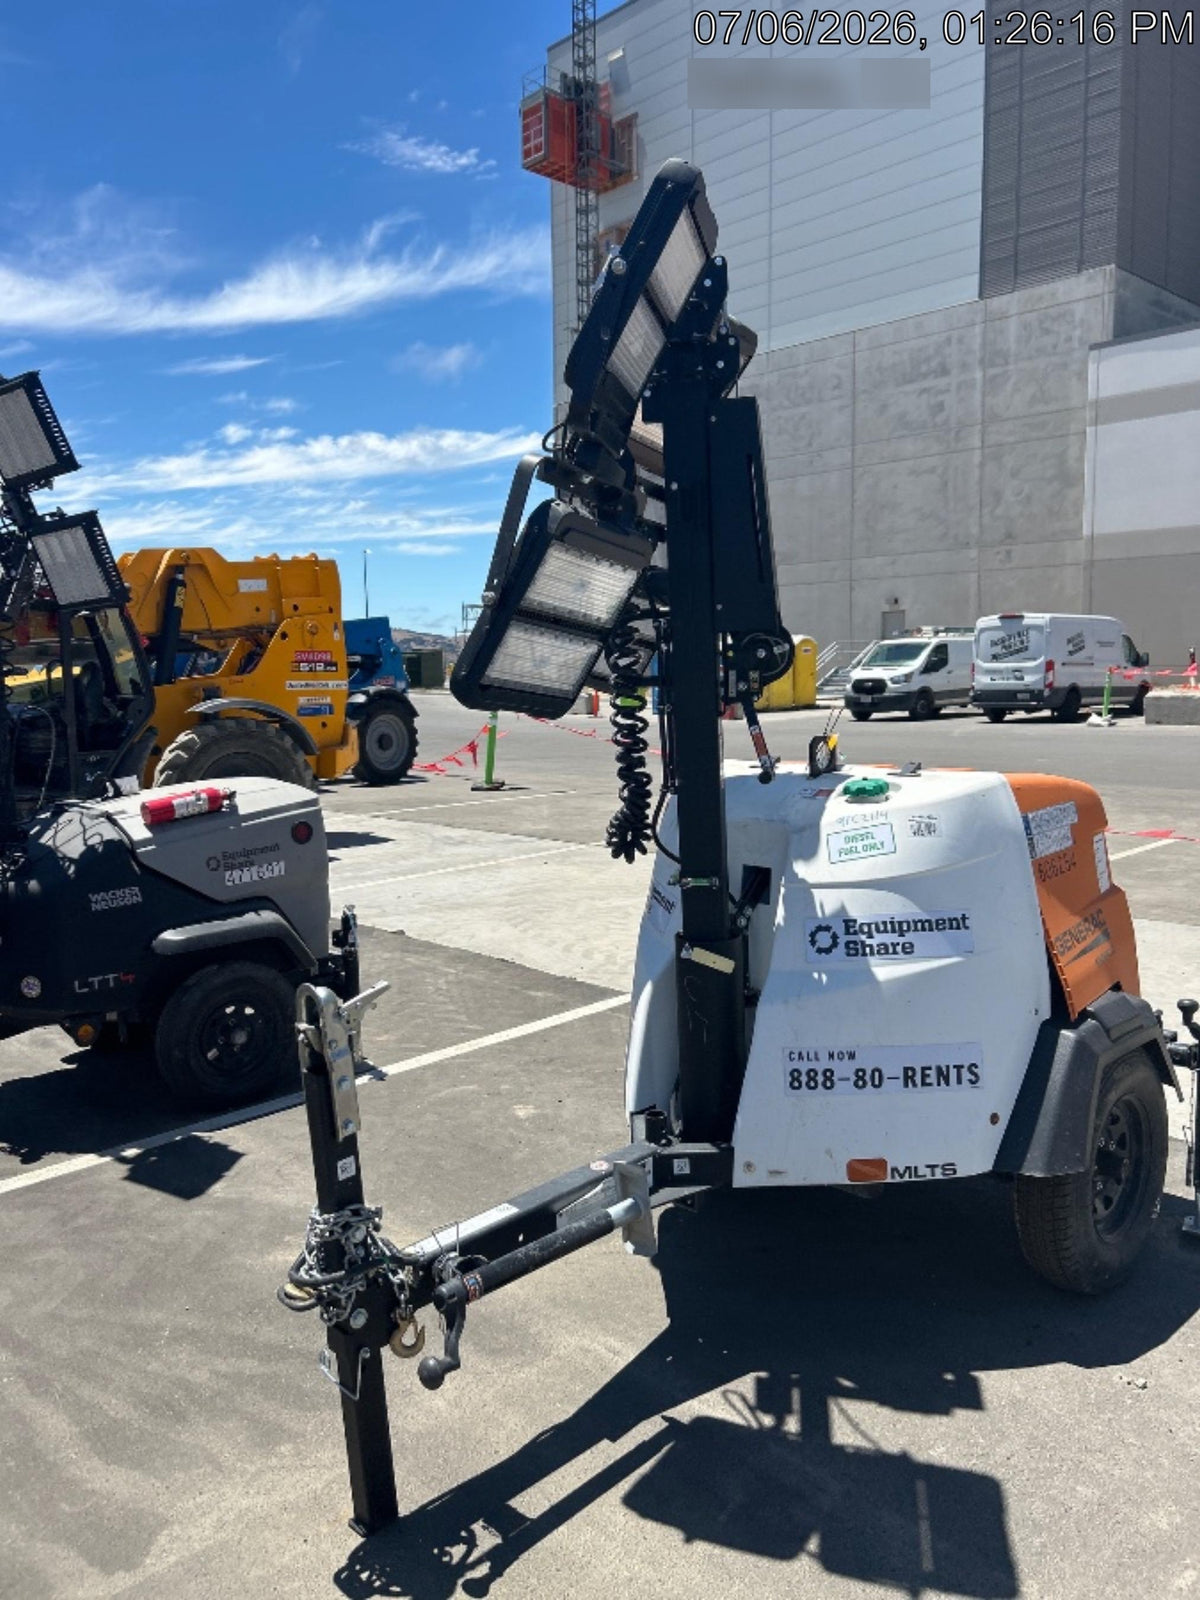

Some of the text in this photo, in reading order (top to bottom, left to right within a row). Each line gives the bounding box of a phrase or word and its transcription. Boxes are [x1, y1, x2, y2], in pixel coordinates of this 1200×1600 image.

[844, 831, 877, 845] DIESEL
[221, 842, 281, 861] Equipment
[838, 841, 886, 858] FUEL ONLY
[88, 886, 142, 903] WACKER
[91, 895, 143, 912] NEUSON
[842, 913, 970, 939] Equipment
[1052, 908, 1108, 957] GENERAC
[843, 940, 915, 958] Share
[74, 972, 136, 993] LTT4
[788, 1050, 857, 1063] CALL NOW
[788, 1062, 981, 1091] 888-80-RENTS
[889, 1162, 958, 1180] MLTS
